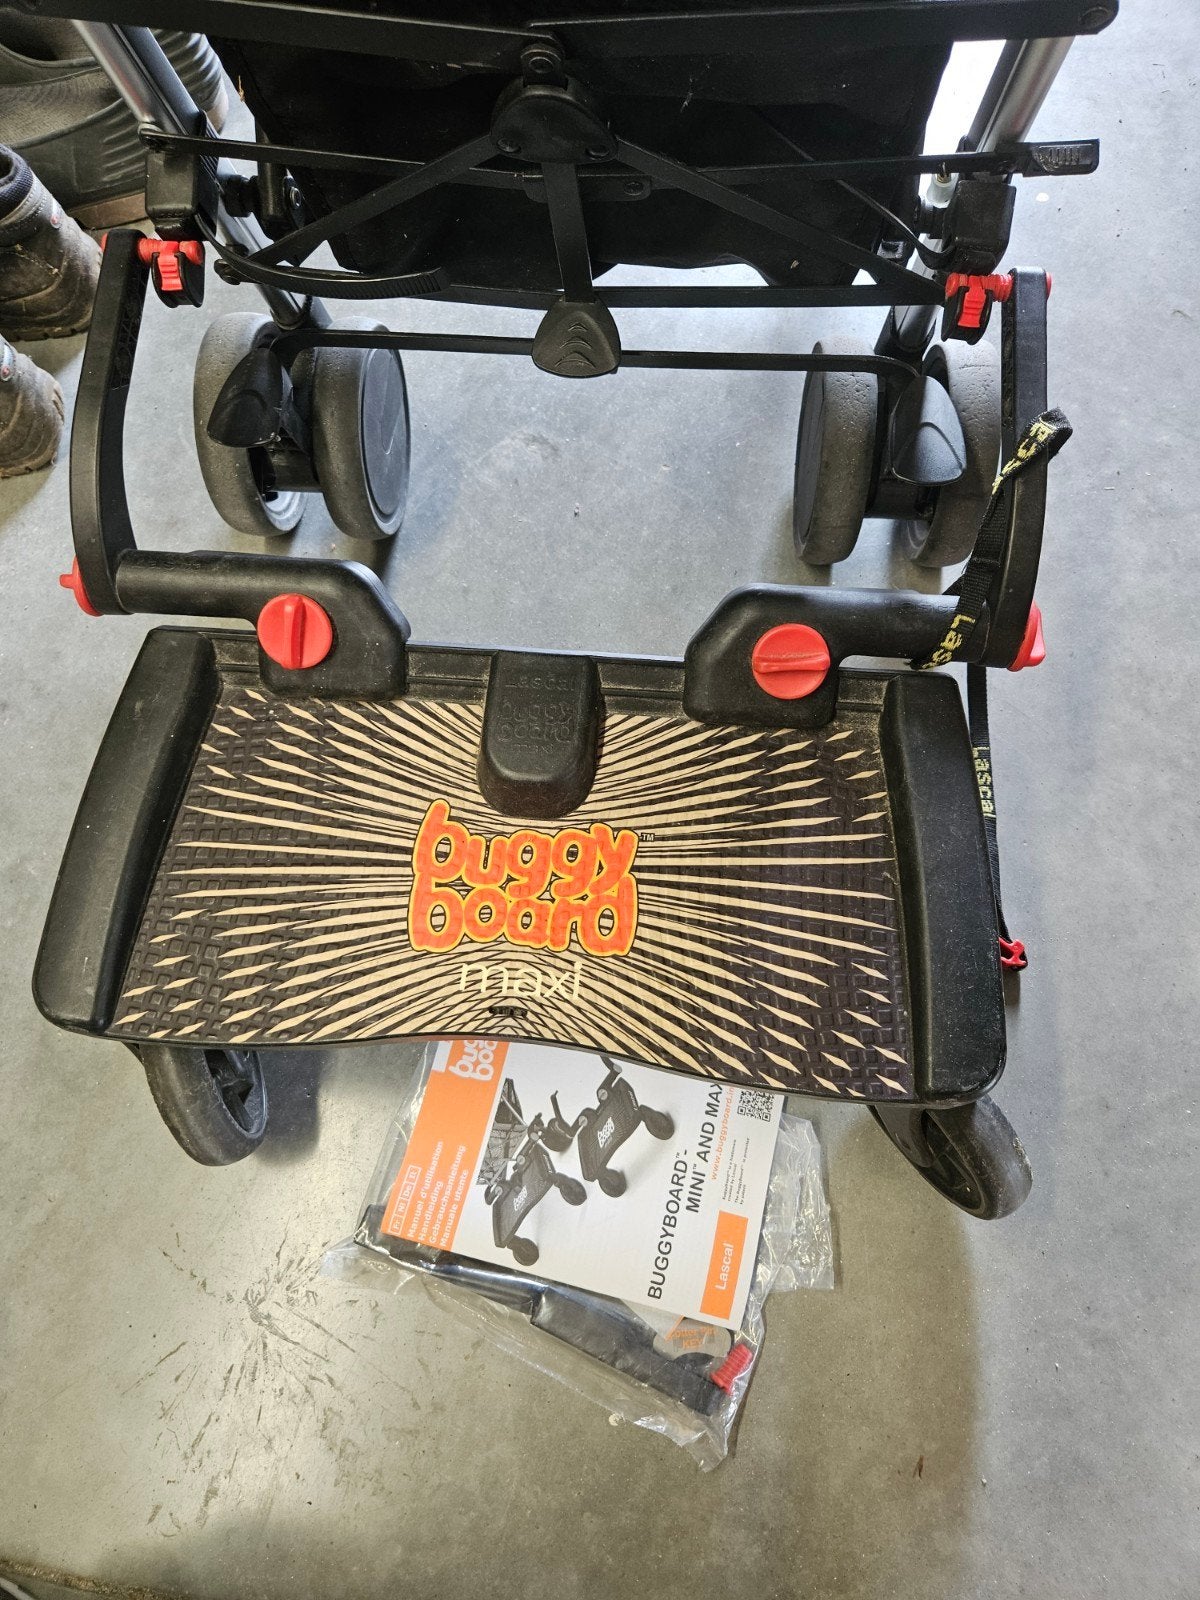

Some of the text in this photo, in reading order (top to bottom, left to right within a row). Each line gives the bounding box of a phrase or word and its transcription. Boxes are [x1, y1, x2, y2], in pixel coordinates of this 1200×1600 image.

[962, 746, 997, 818] Lascal
[412, 798, 640, 899] buggy
[407, 872, 640, 957] board
[457, 960, 583, 1001] maxi
[696, 1121, 716, 1163] AND
[407, 1200, 425, 1238] Manuel
[418, 1180, 444, 1241] Handleiding
[429, 1144, 466, 1244] Gebrauchsanleitung
[440, 1203, 459, 1247] Manuale
[715, 1242, 735, 1291] Lascal
